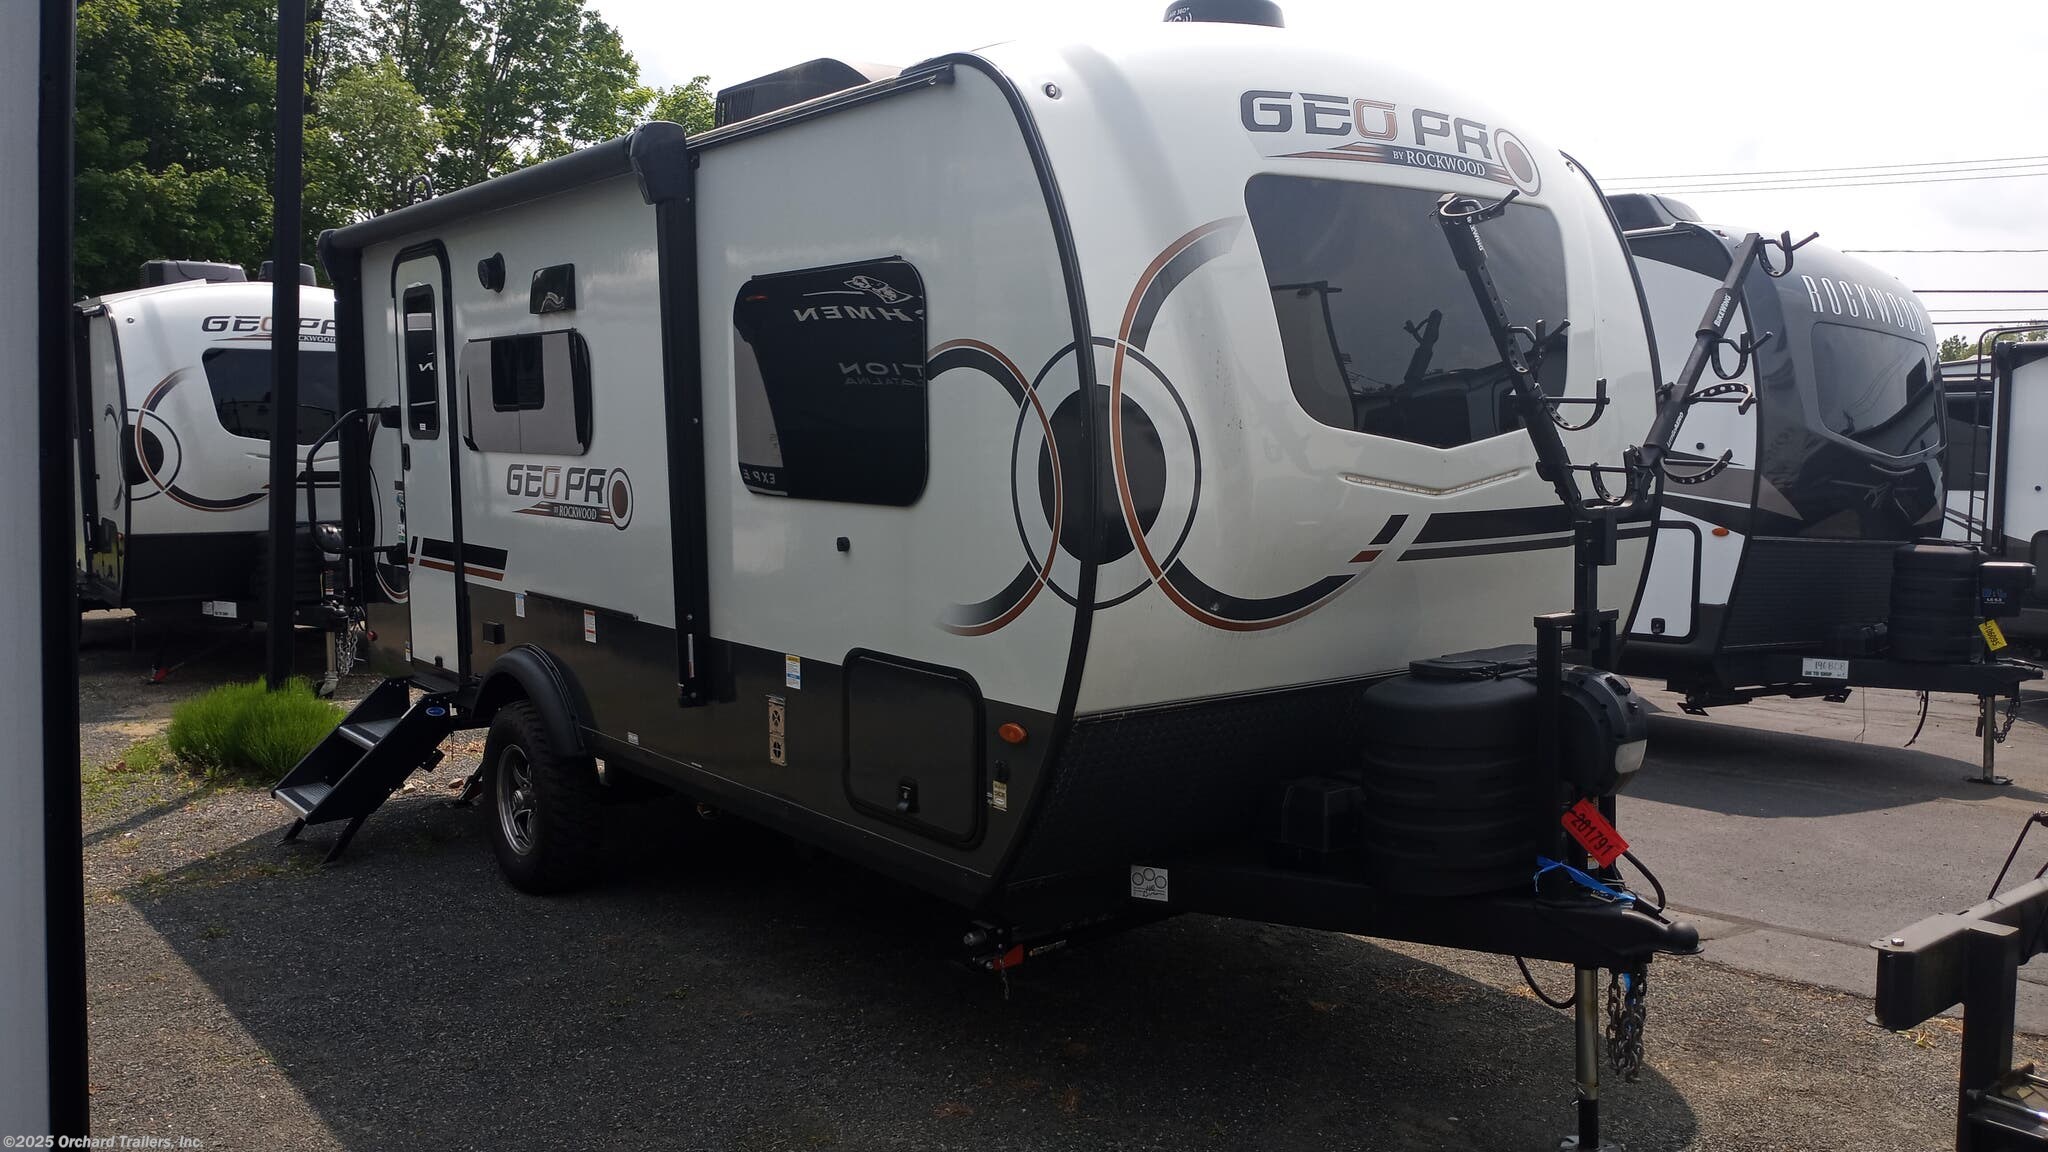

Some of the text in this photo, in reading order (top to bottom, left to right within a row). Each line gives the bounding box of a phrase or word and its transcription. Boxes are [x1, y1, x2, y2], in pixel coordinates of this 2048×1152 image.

[1240, 90, 1542, 197] GEO PRO
[1393, 150, 1486, 177] BY ROCKWOOD
[1801, 275, 1926, 336] ROCKWOOD
[507, 464, 634, 531] GEO PRO
[560, 508, 597, 520] ROCKWOOD
